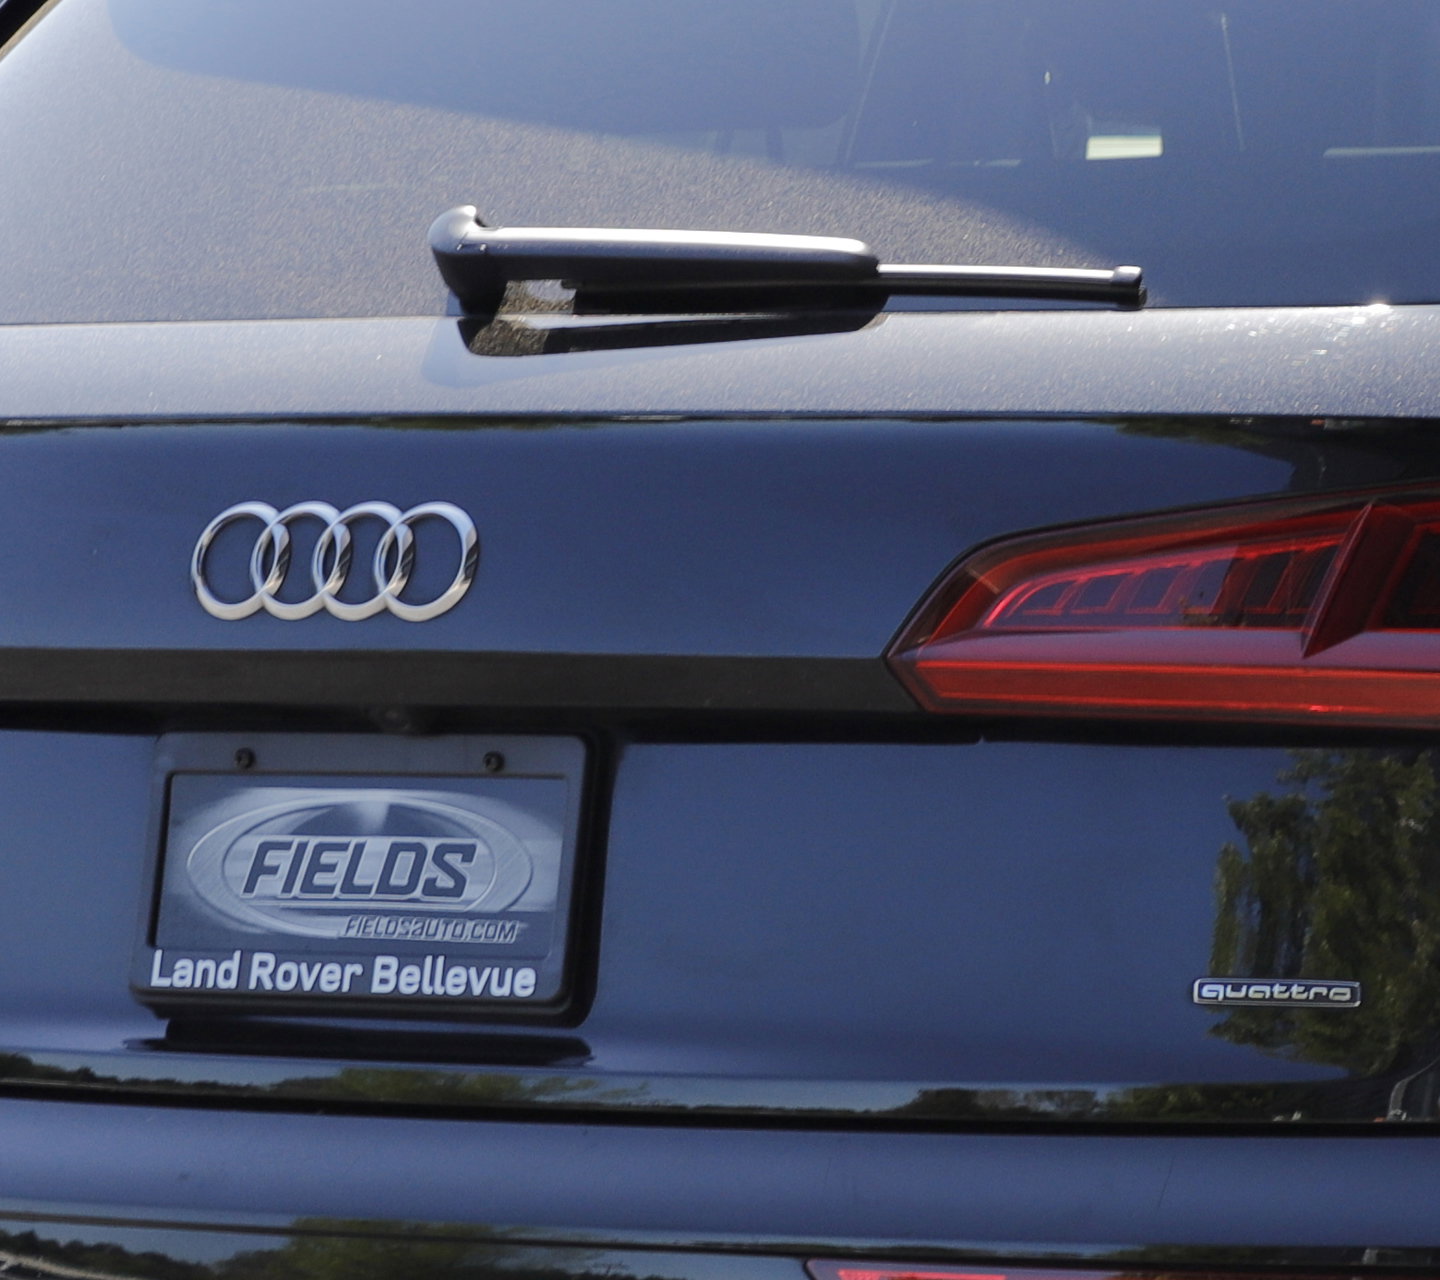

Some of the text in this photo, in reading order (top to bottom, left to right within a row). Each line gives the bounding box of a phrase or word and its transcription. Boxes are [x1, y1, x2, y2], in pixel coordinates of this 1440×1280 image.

[242, 839, 478, 900] FIELDS
[150, 949, 537, 998] Land Rover Bellevue
[1200, 982, 1352, 1002] quattro
